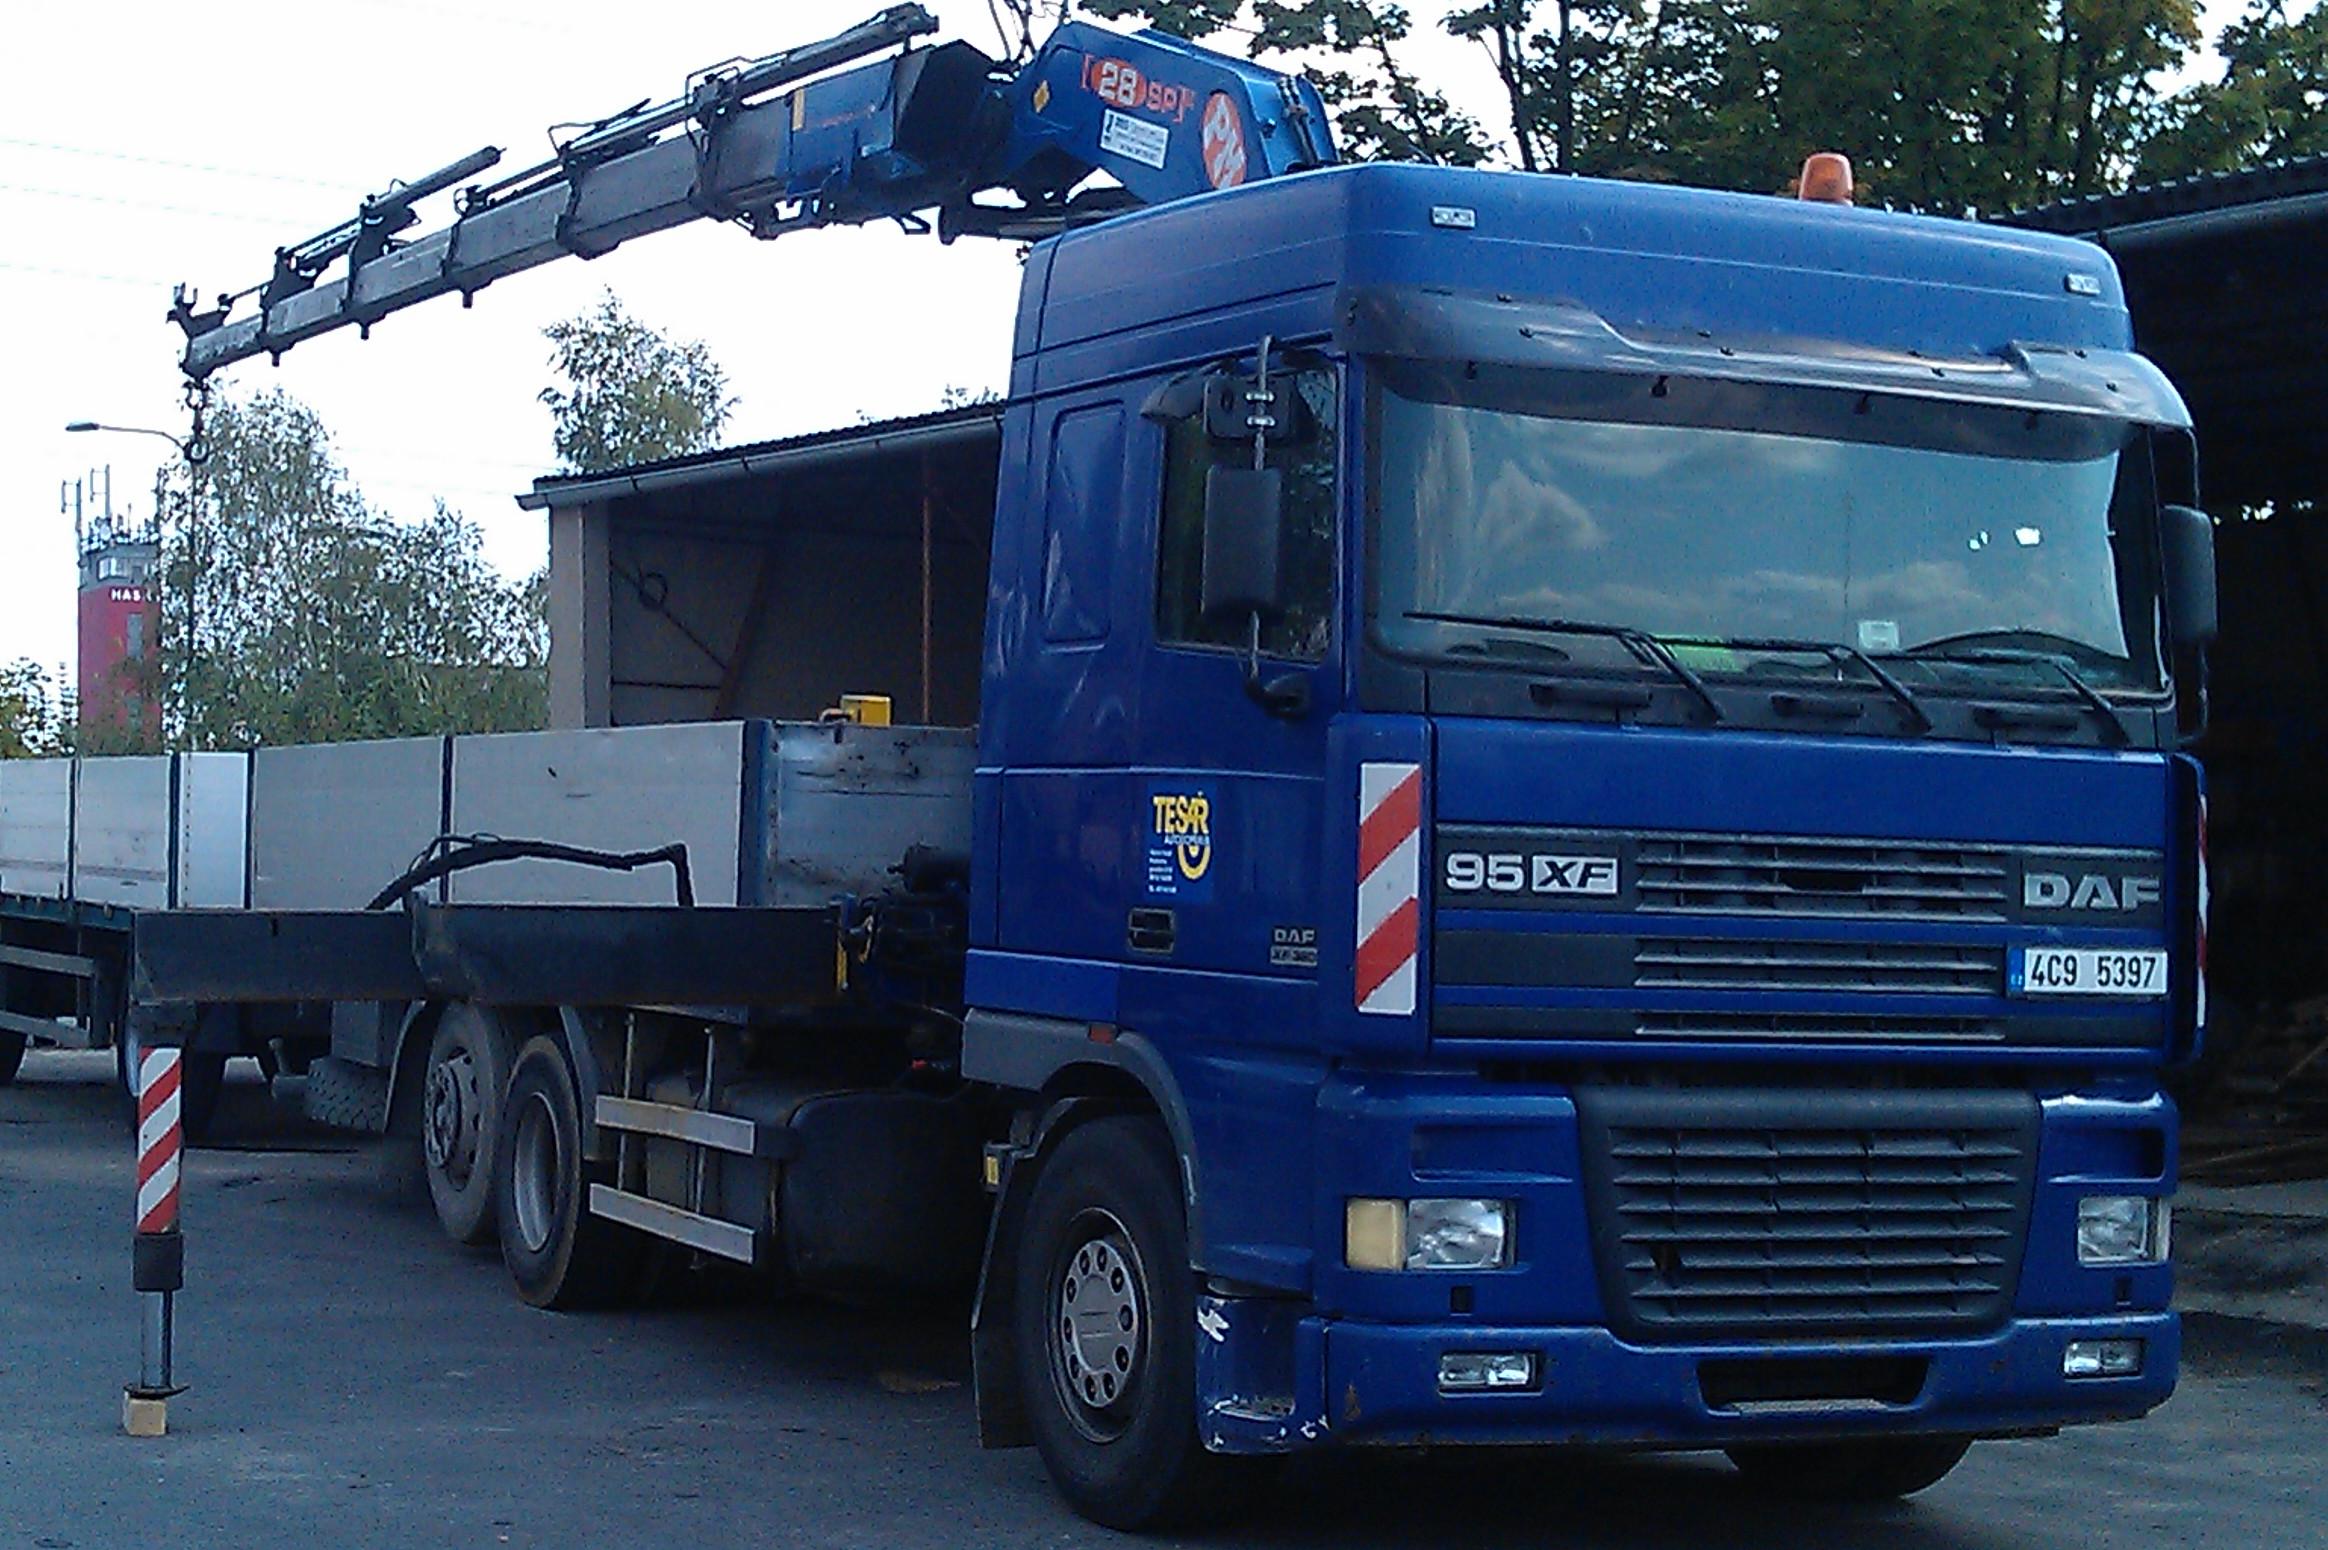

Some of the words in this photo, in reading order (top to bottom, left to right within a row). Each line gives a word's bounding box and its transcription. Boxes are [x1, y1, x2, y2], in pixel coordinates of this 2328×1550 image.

[1098, 61, 1138, 106] 28
[2024, 872, 2160, 911] DAF
[1274, 928, 1316, 945] DAF
[2031, 954, 2078, 987] 4C9
[2097, 955, 2156, 988] 5397
